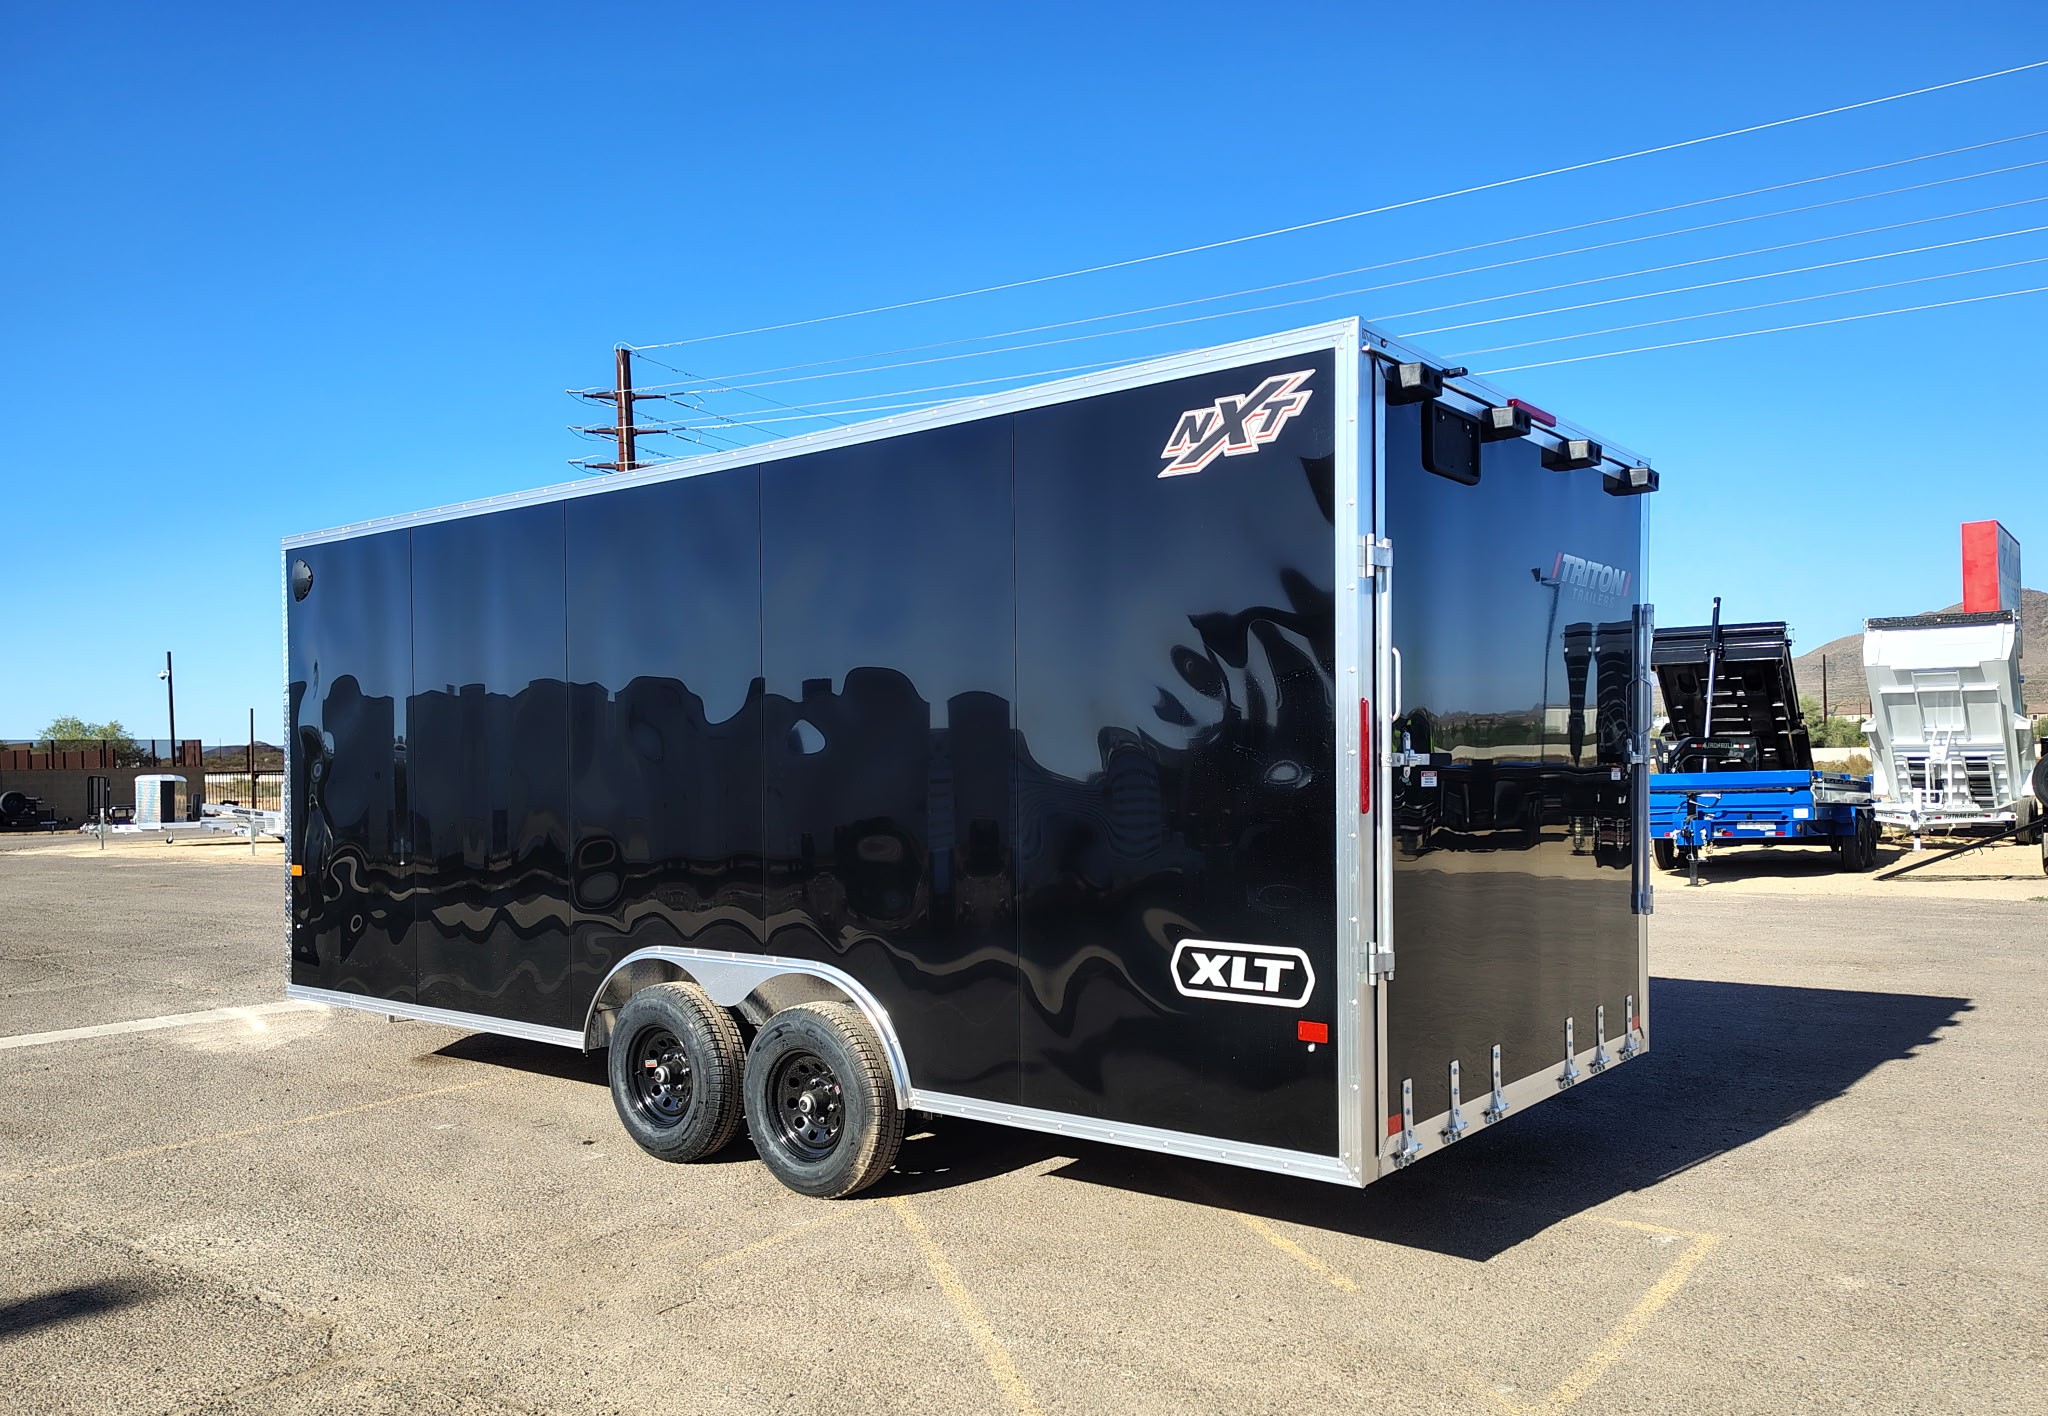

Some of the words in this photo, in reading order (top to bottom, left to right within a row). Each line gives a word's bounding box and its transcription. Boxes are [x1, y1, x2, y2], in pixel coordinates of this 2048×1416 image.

[1158, 369, 1315, 478] NXT
[1561, 553, 1626, 596] TRITON
[1573, 587, 1615, 608] TRAILERS
[1188, 952, 1295, 993] XLT
